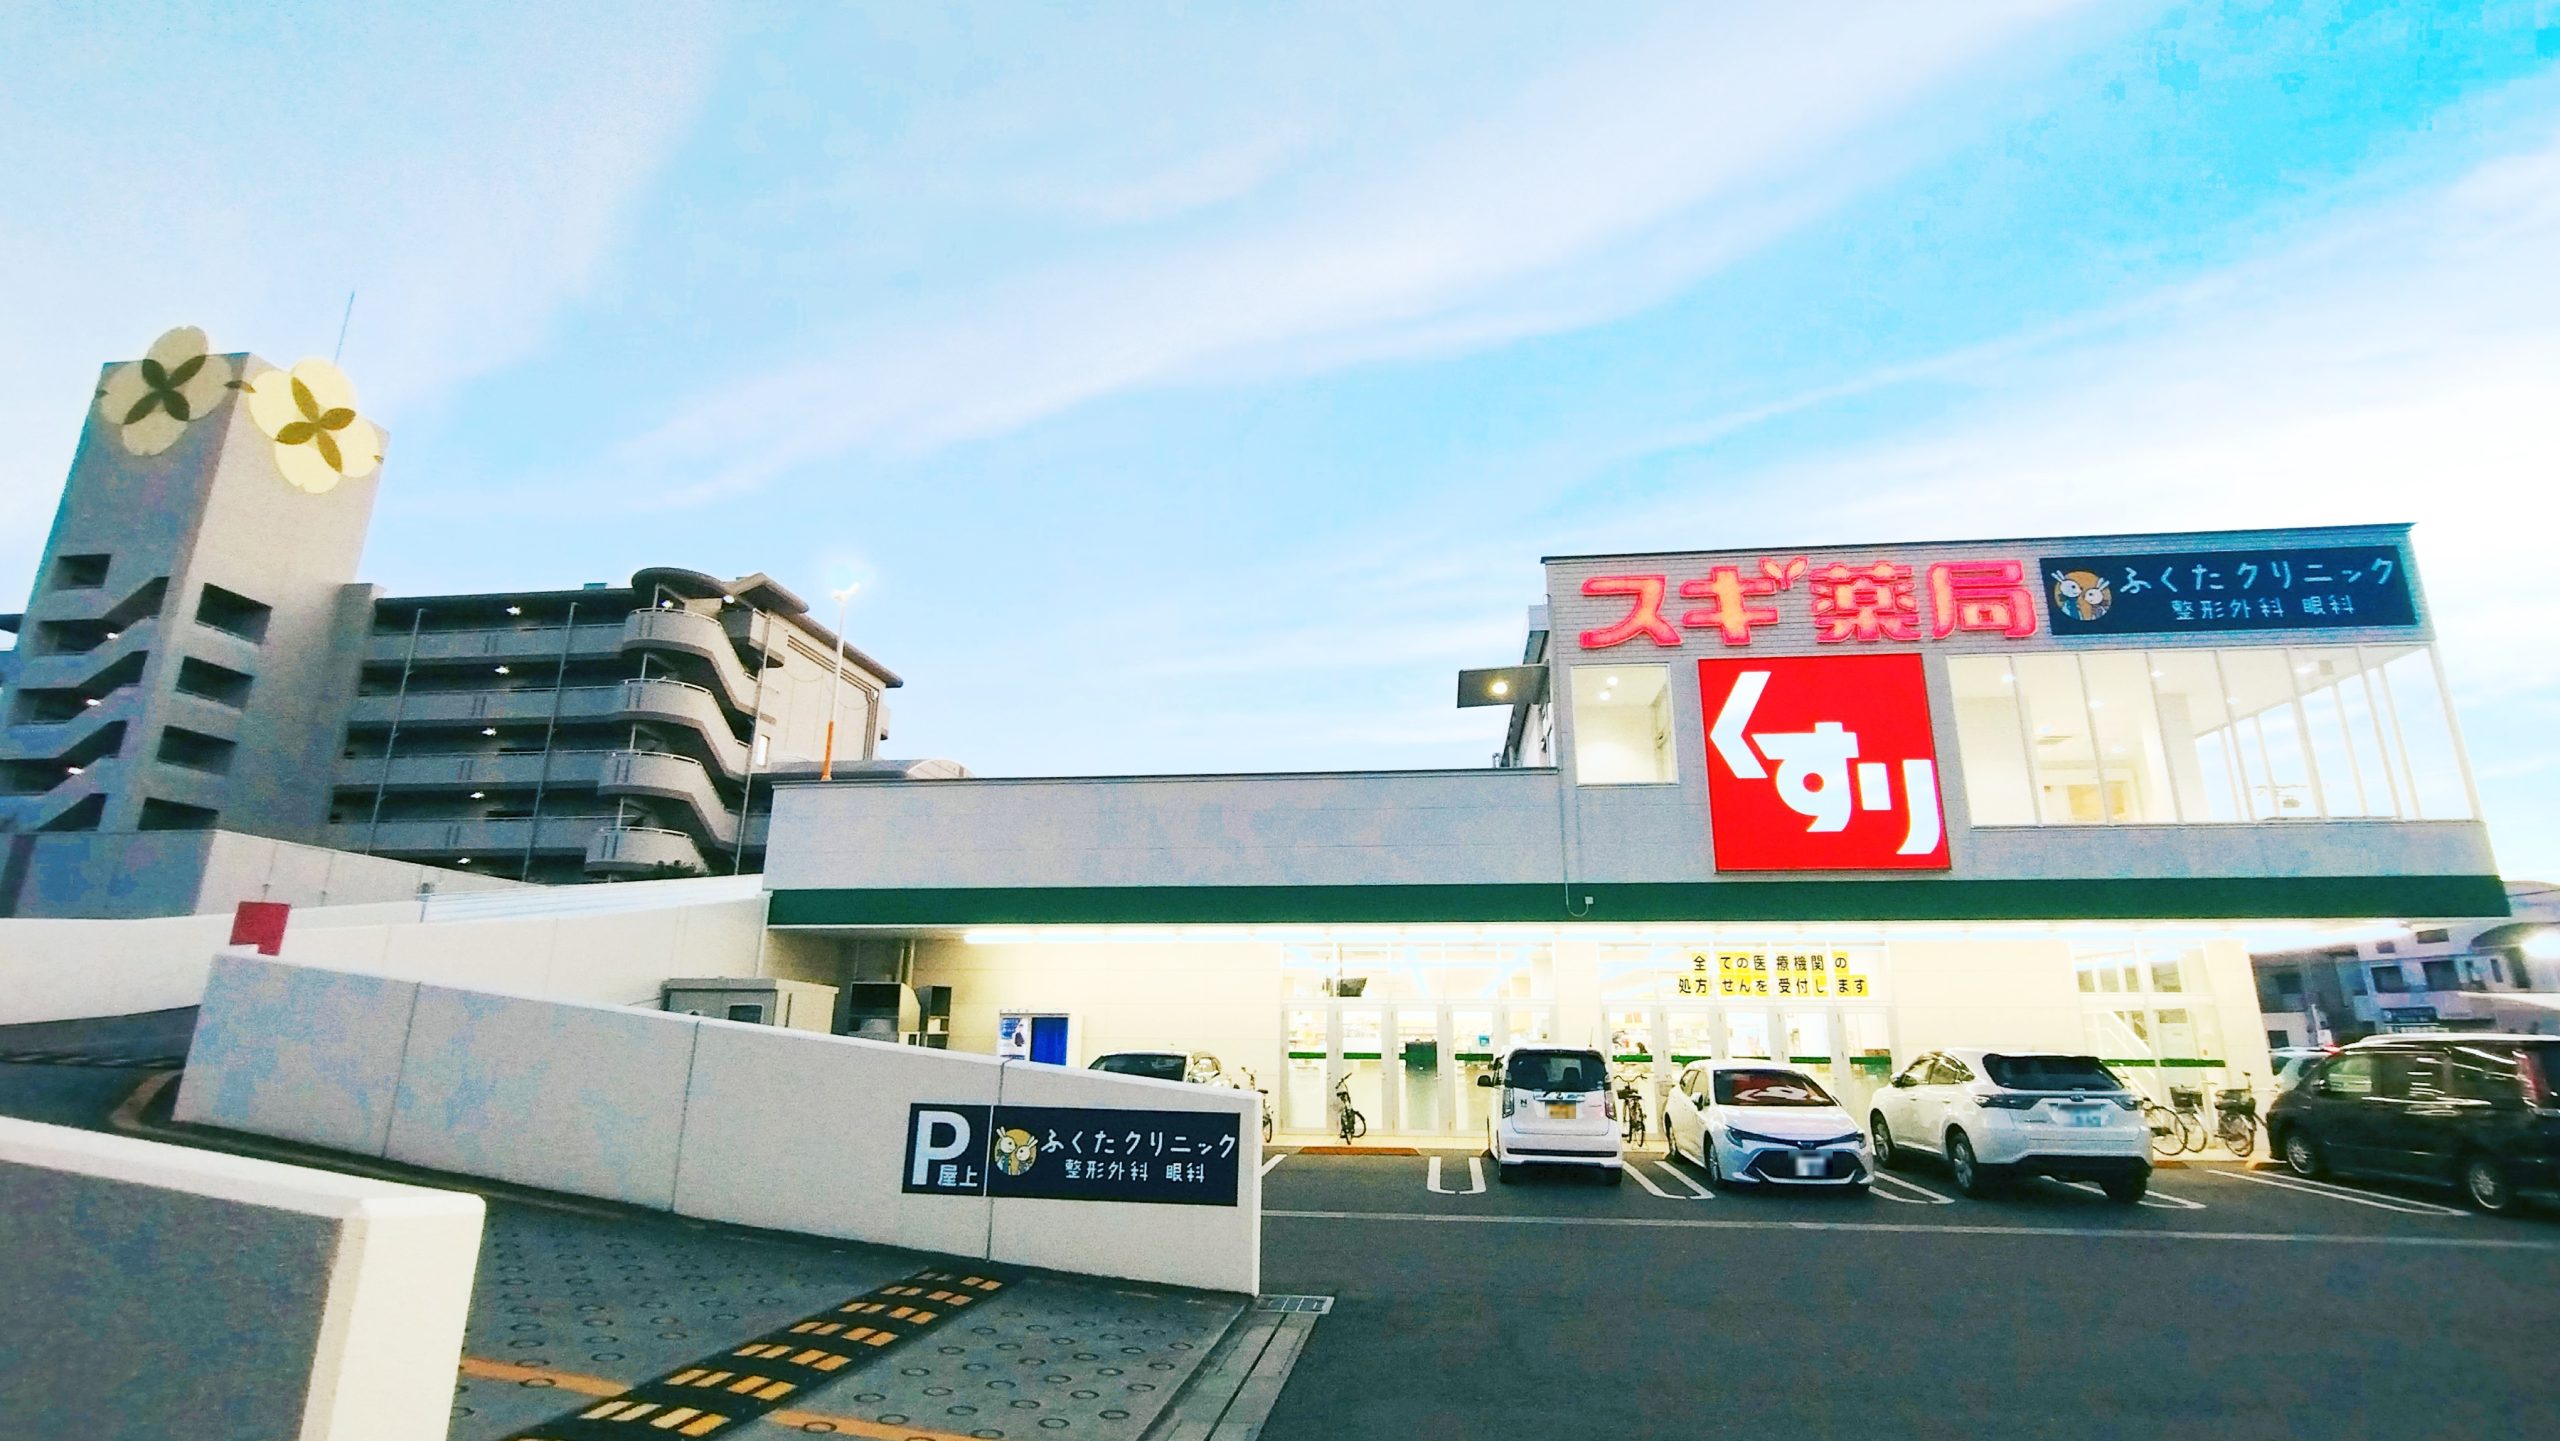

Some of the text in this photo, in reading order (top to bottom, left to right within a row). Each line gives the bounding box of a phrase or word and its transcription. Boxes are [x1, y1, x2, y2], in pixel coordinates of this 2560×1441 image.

[2119, 557, 2394, 594] ふくたクリニック
[1579, 556, 2038, 650] スギ薬局
[2171, 594, 2354, 621] 整形外科 眼科
[1710, 671, 1941, 855] くすり
[1679, 977, 1868, 994] 処方せんを受付します
[912, 1110, 971, 1186] P
[1040, 1128, 1236, 1159] ふくたクリニック
[937, 1164, 978, 1187] 屋上
[1065, 1159, 1204, 1183] 整形外科 眼科
